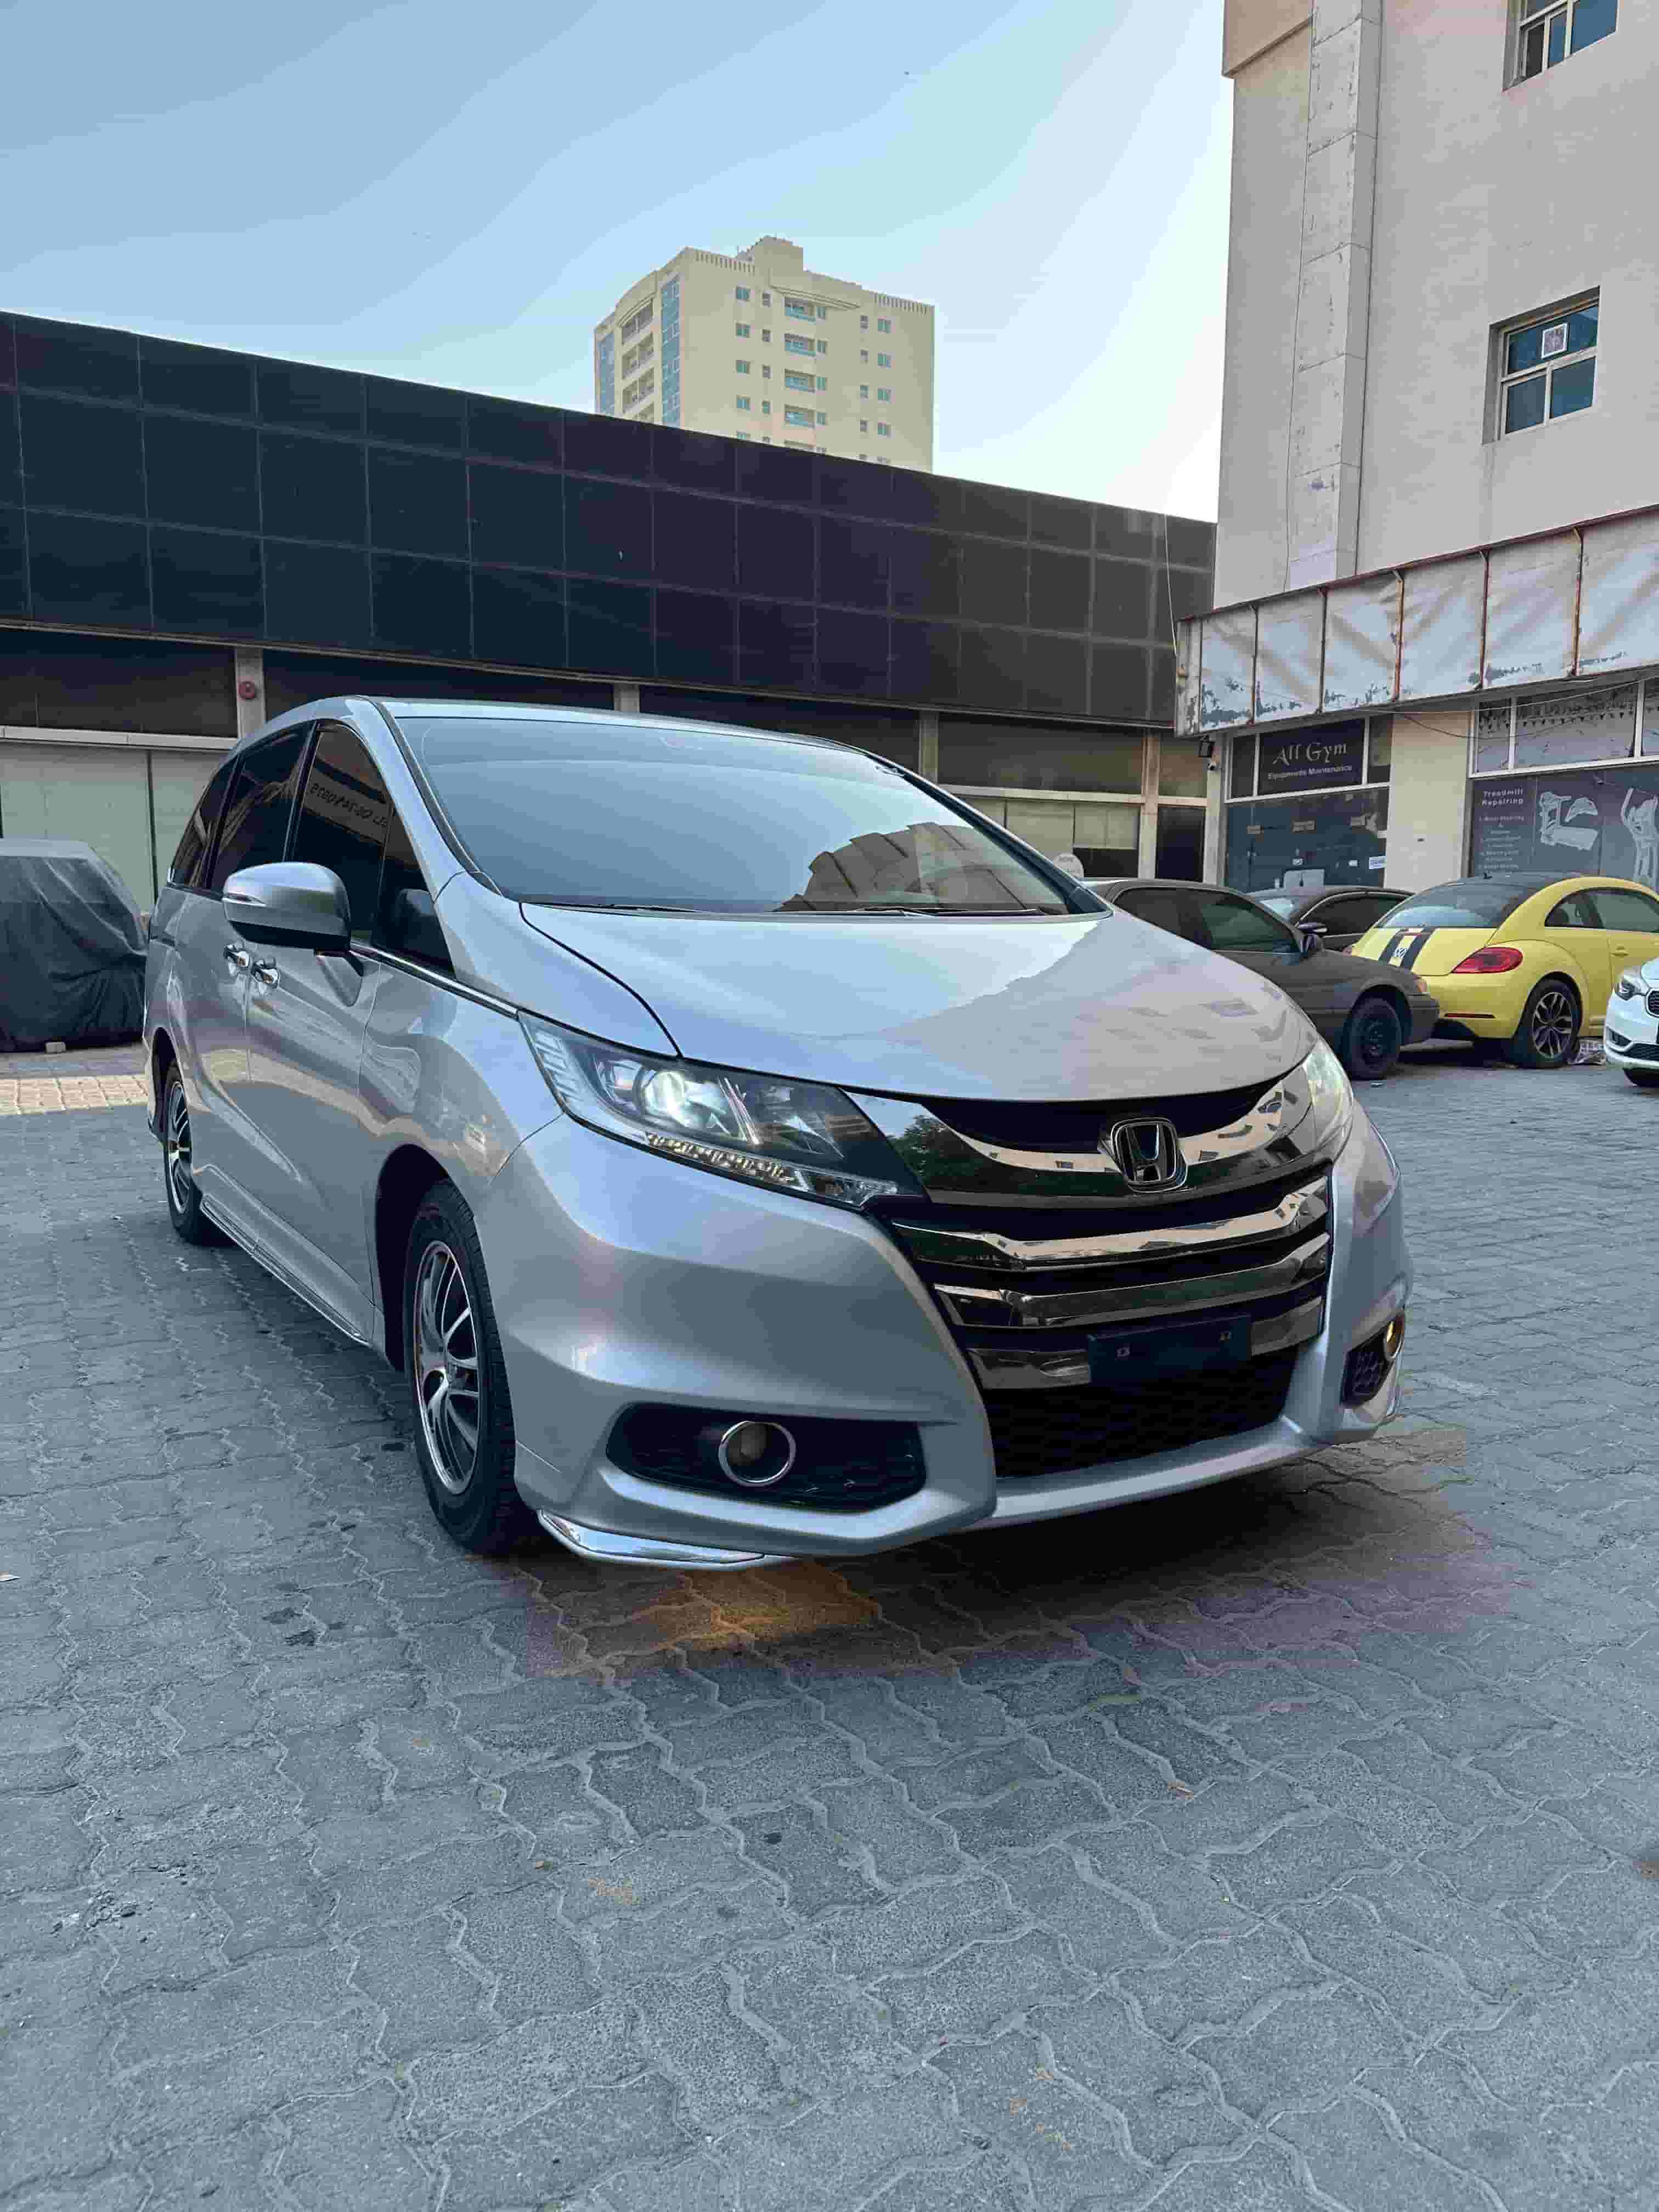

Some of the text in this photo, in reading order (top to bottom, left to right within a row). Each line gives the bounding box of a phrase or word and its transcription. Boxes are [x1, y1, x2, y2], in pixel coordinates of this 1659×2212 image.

[1272, 742, 1347, 765] All Gym
[1483, 788, 1523, 797] Treadmill
[1482, 798, 1523, 808] Repairing
